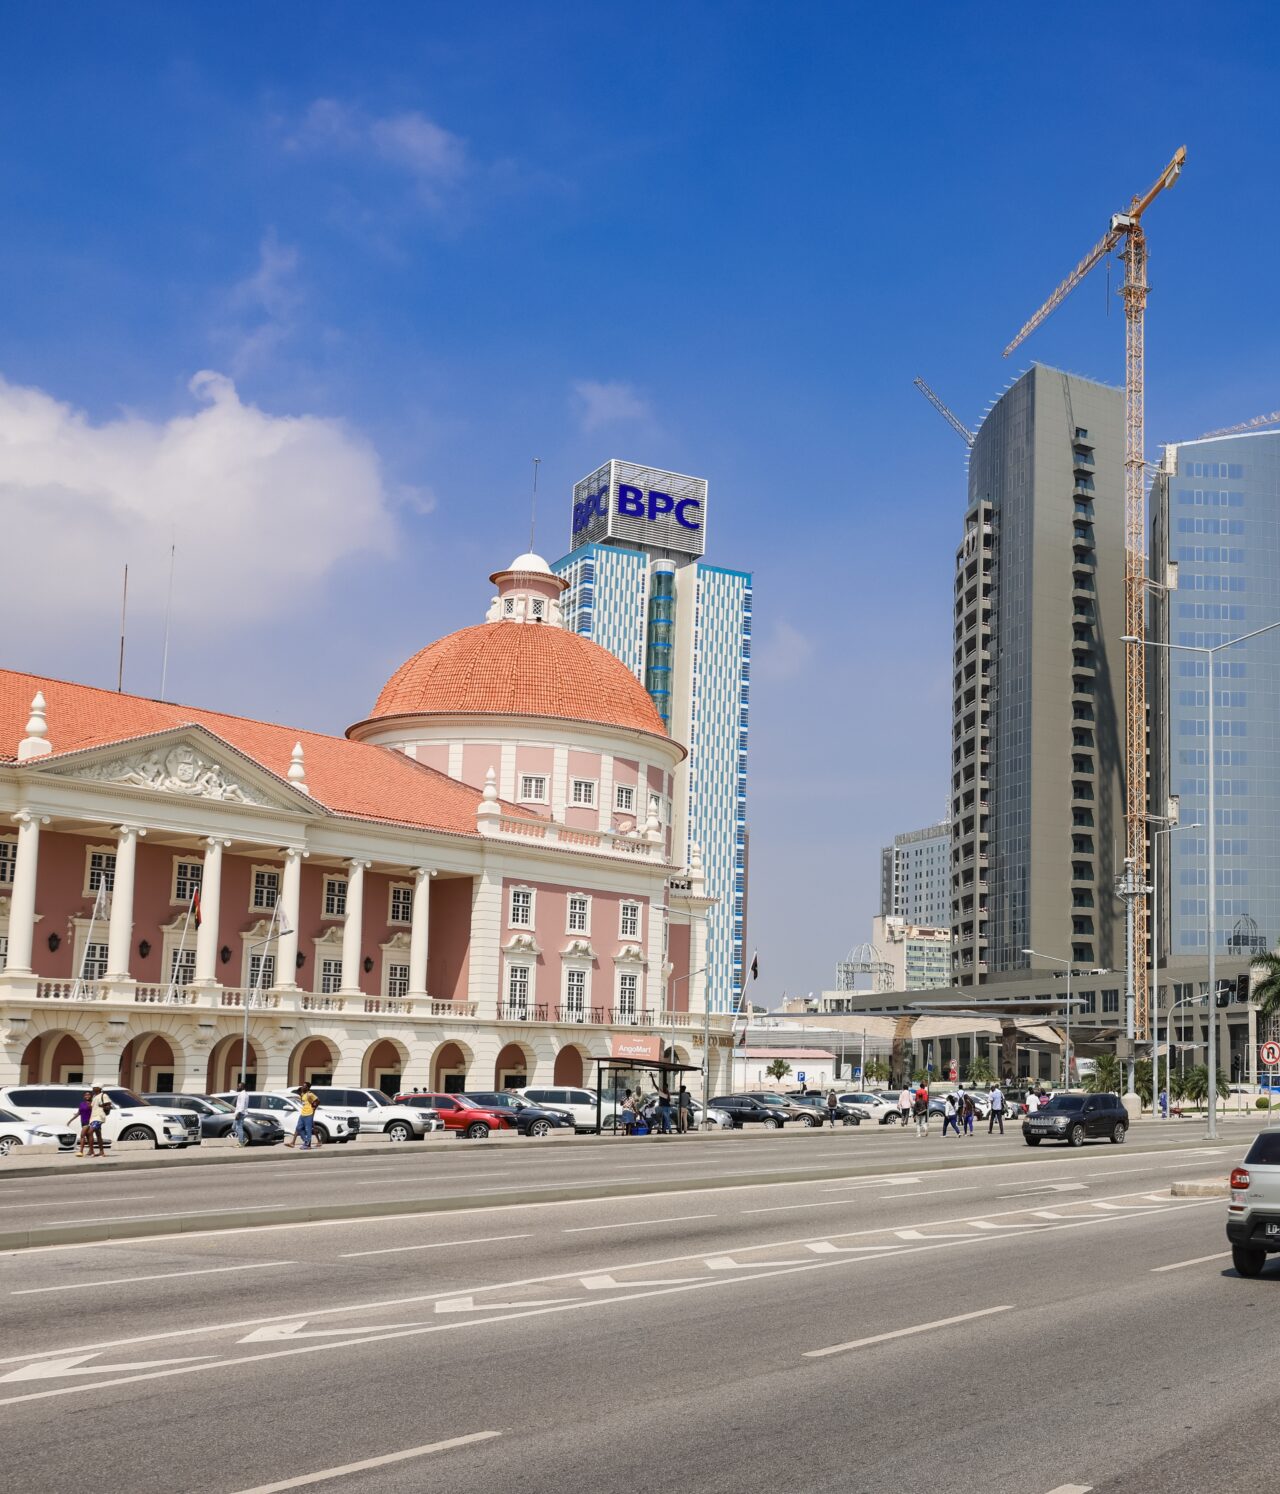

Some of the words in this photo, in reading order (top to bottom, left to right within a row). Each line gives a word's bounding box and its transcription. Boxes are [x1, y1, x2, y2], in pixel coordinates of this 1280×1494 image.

[618, 484, 700, 530] BPC
[692, 1035, 719, 1048] BACO
[619, 1045, 651, 1054] AngoMart
